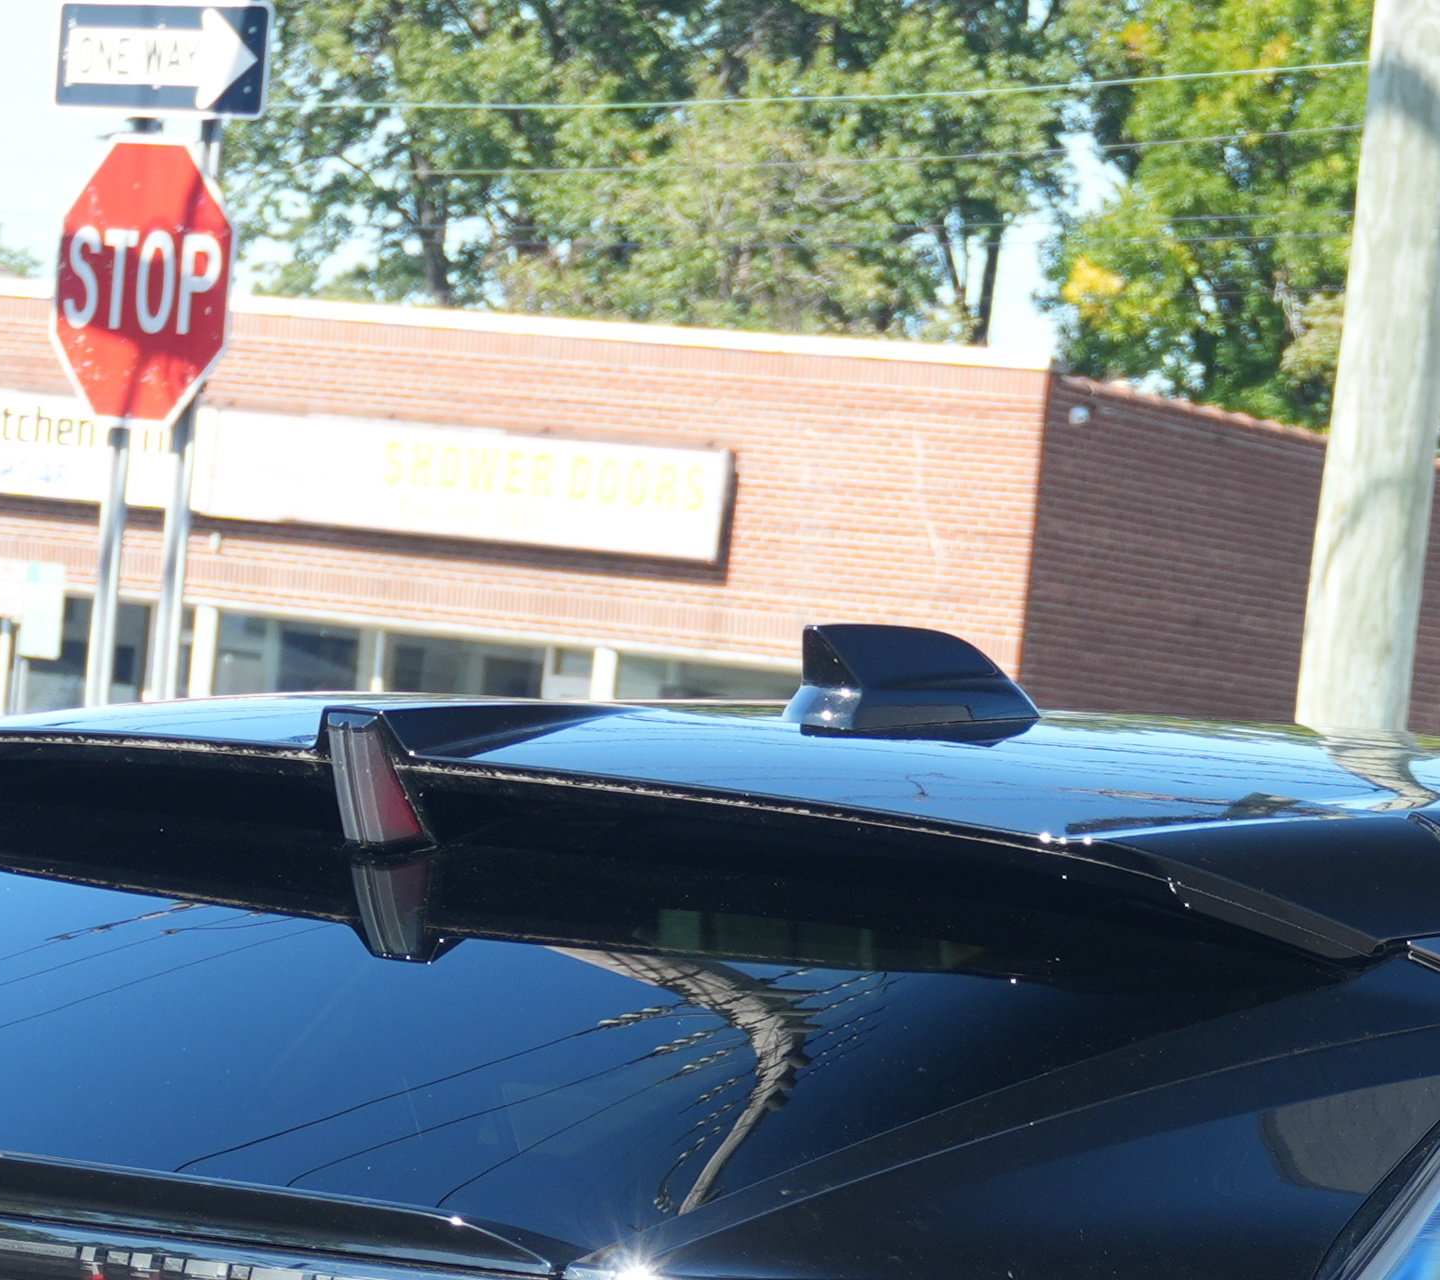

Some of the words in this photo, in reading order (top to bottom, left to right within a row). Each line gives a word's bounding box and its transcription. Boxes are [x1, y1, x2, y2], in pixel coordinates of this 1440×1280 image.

[78, 36, 130, 75] ONE
[145, 37, 201, 75] WAY
[63, 225, 223, 336] STOP
[383, 439, 554, 500] SHOWER
[567, 455, 709, 513] DOORS
